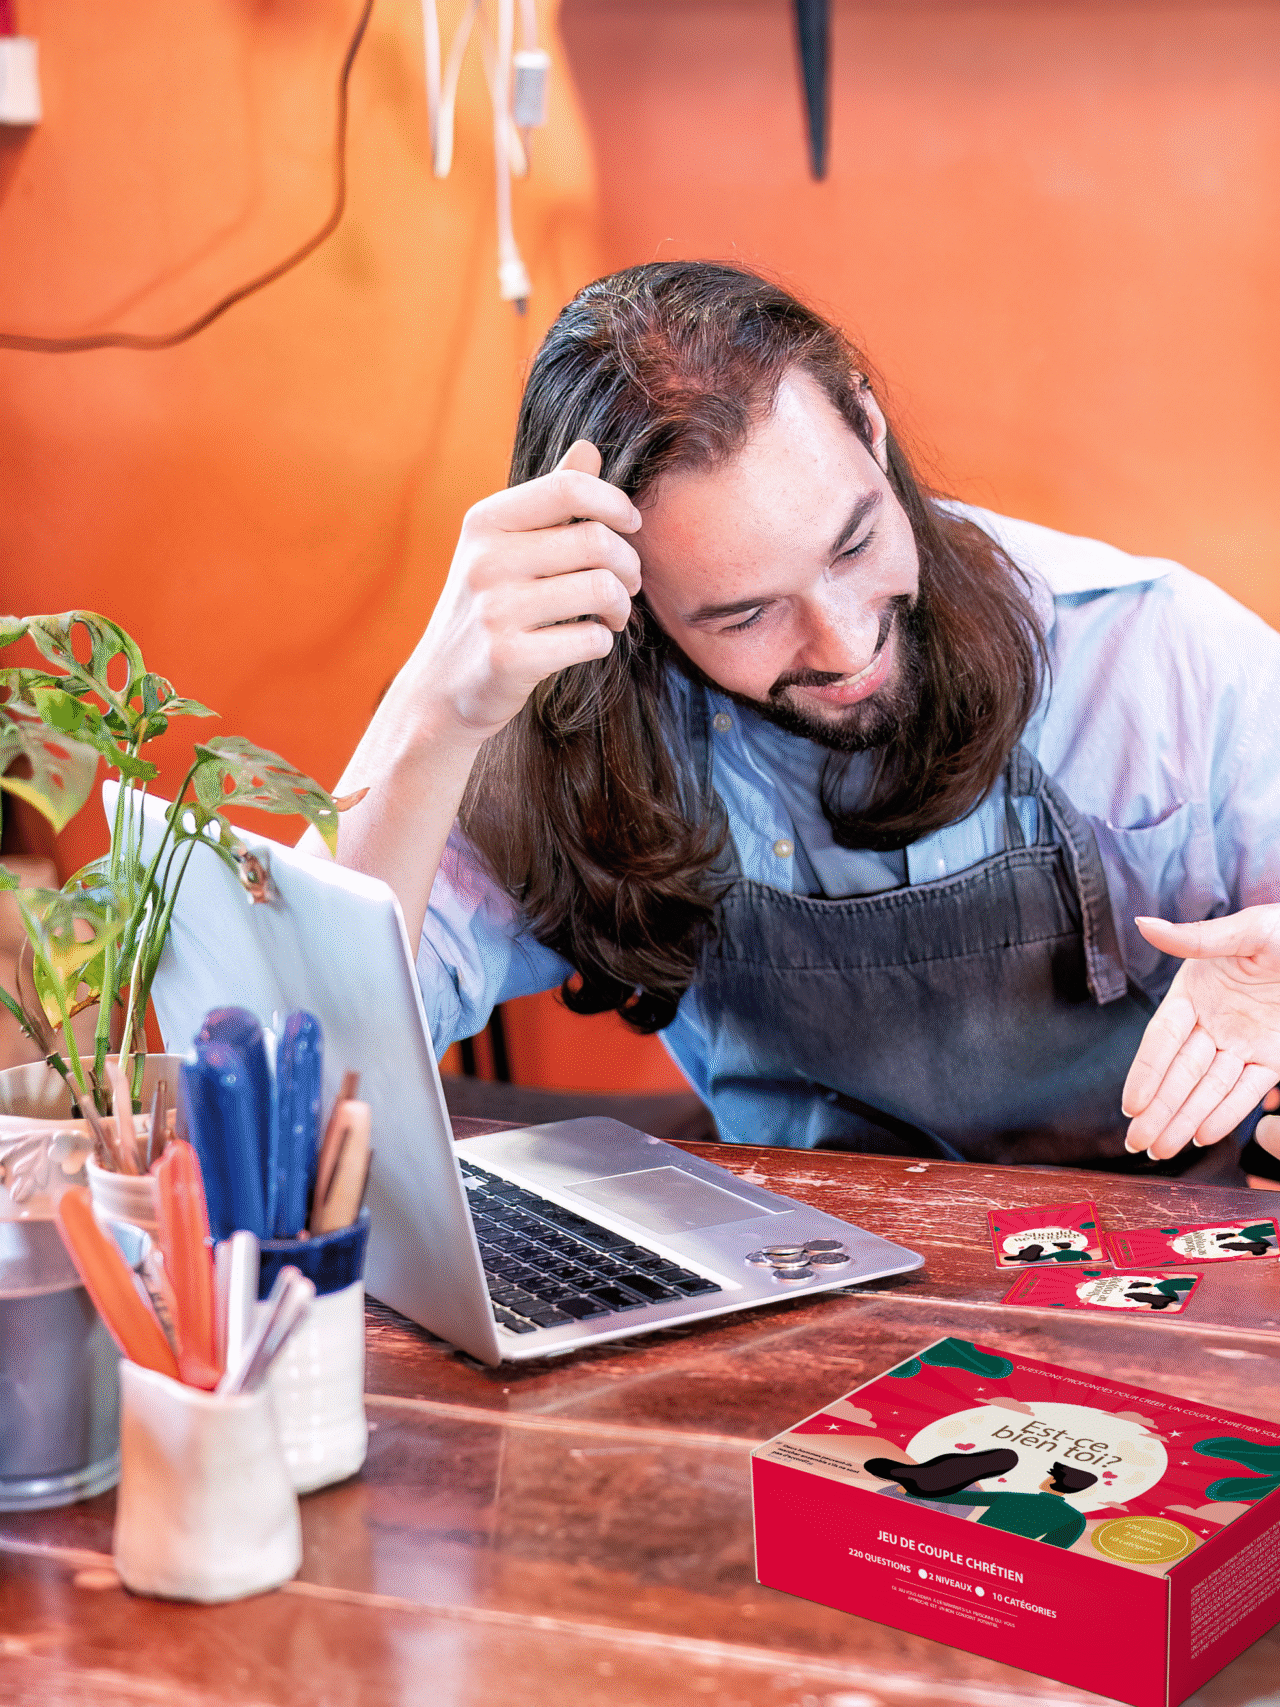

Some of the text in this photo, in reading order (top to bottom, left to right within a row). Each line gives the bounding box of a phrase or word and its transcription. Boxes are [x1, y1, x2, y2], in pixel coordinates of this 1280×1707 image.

[1016, 1364, 1063, 1380] QUESTIONS
[1063, 1377, 1114, 1394] PROFONDES
[1114, 1389, 1139, 1402] POUR
[1168, 1405, 1182, 1413] UN
[1183, 1408, 1218, 1422] COUPLE
[991, 1425, 1122, 1468] bien toi?
[1020, 1420, 1109, 1453] Est-ce
[848, 1547, 911, 1573] 220 QUESTIONS
[877, 1530, 1023, 1584] JEU DE COUPLE CHRÉTIEN
[929, 1572, 973, 1592] 2 NIVEAUX
[992, 1592, 1057, 1619] 10 CATÉGORIES
